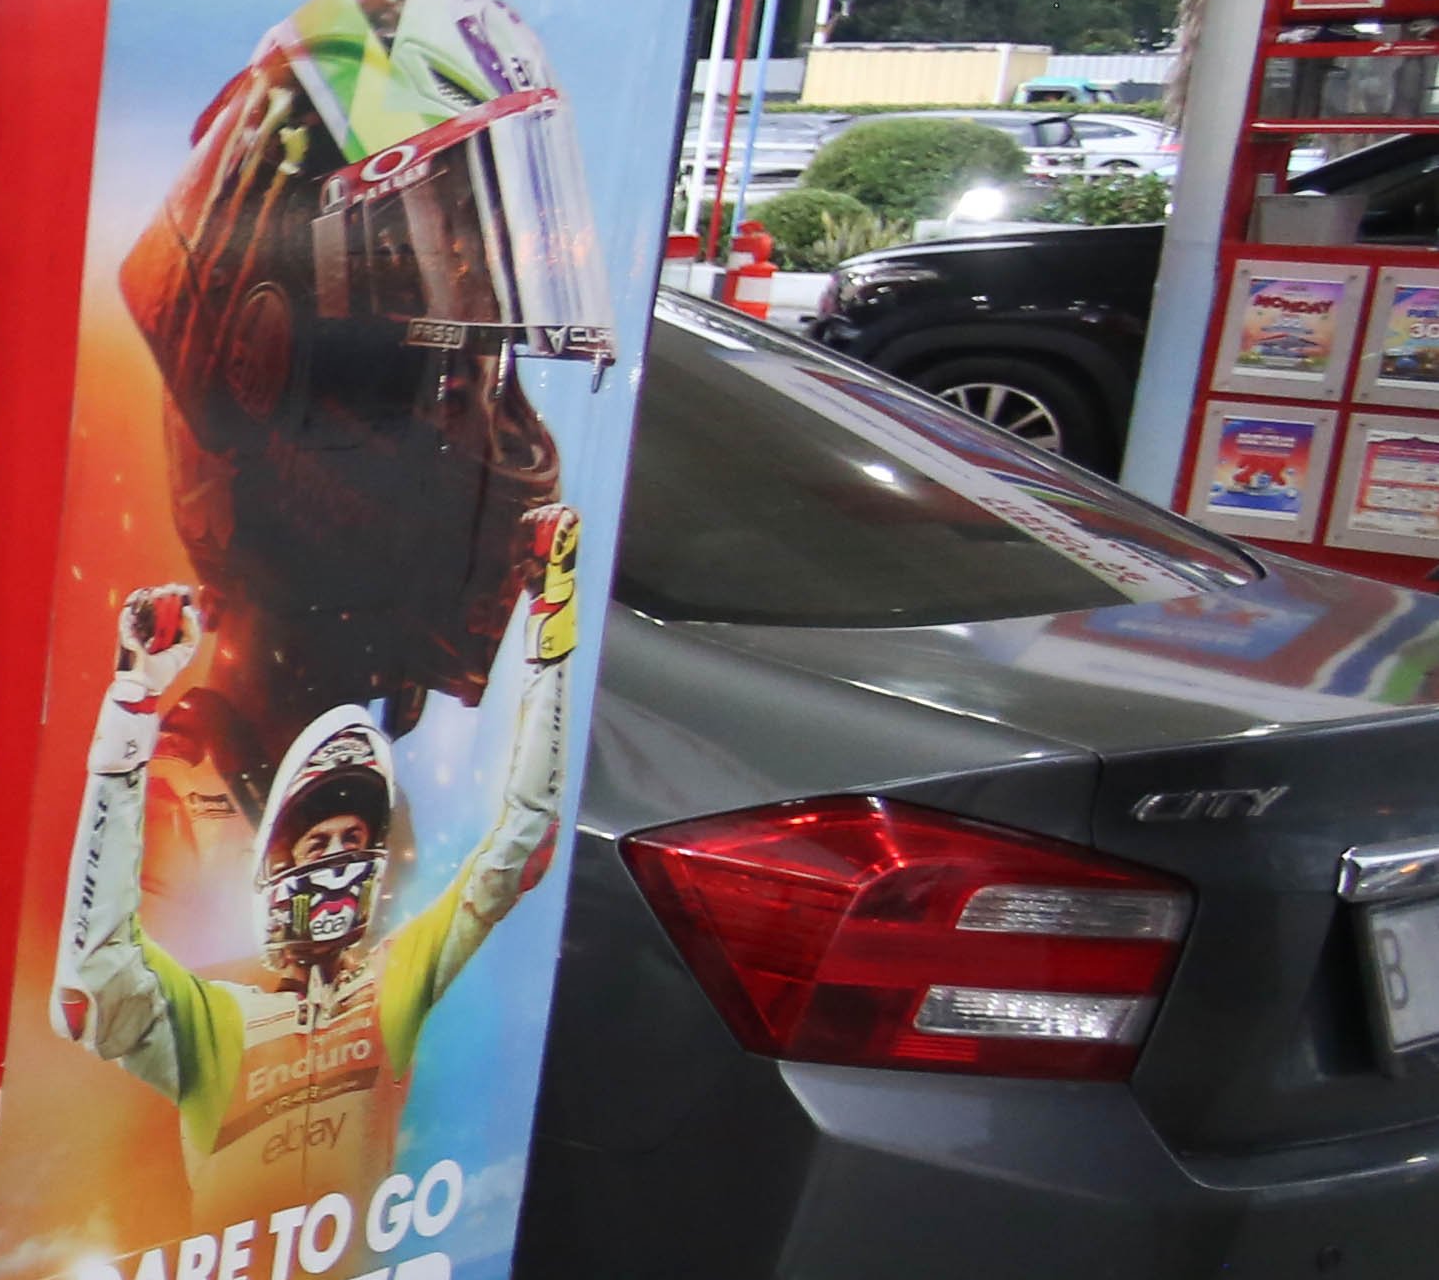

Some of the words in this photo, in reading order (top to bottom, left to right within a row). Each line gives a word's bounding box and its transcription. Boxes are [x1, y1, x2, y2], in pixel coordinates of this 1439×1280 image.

[1253, 294, 1335, 316] MONDAY
[1130, 786, 1290, 821] CITY
[1378, 928, 1410, 1011] B
[247, 1039, 372, 1103] Enduro
[262, 1112, 347, 1166] ebay
[366, 1158, 464, 1253] GO
